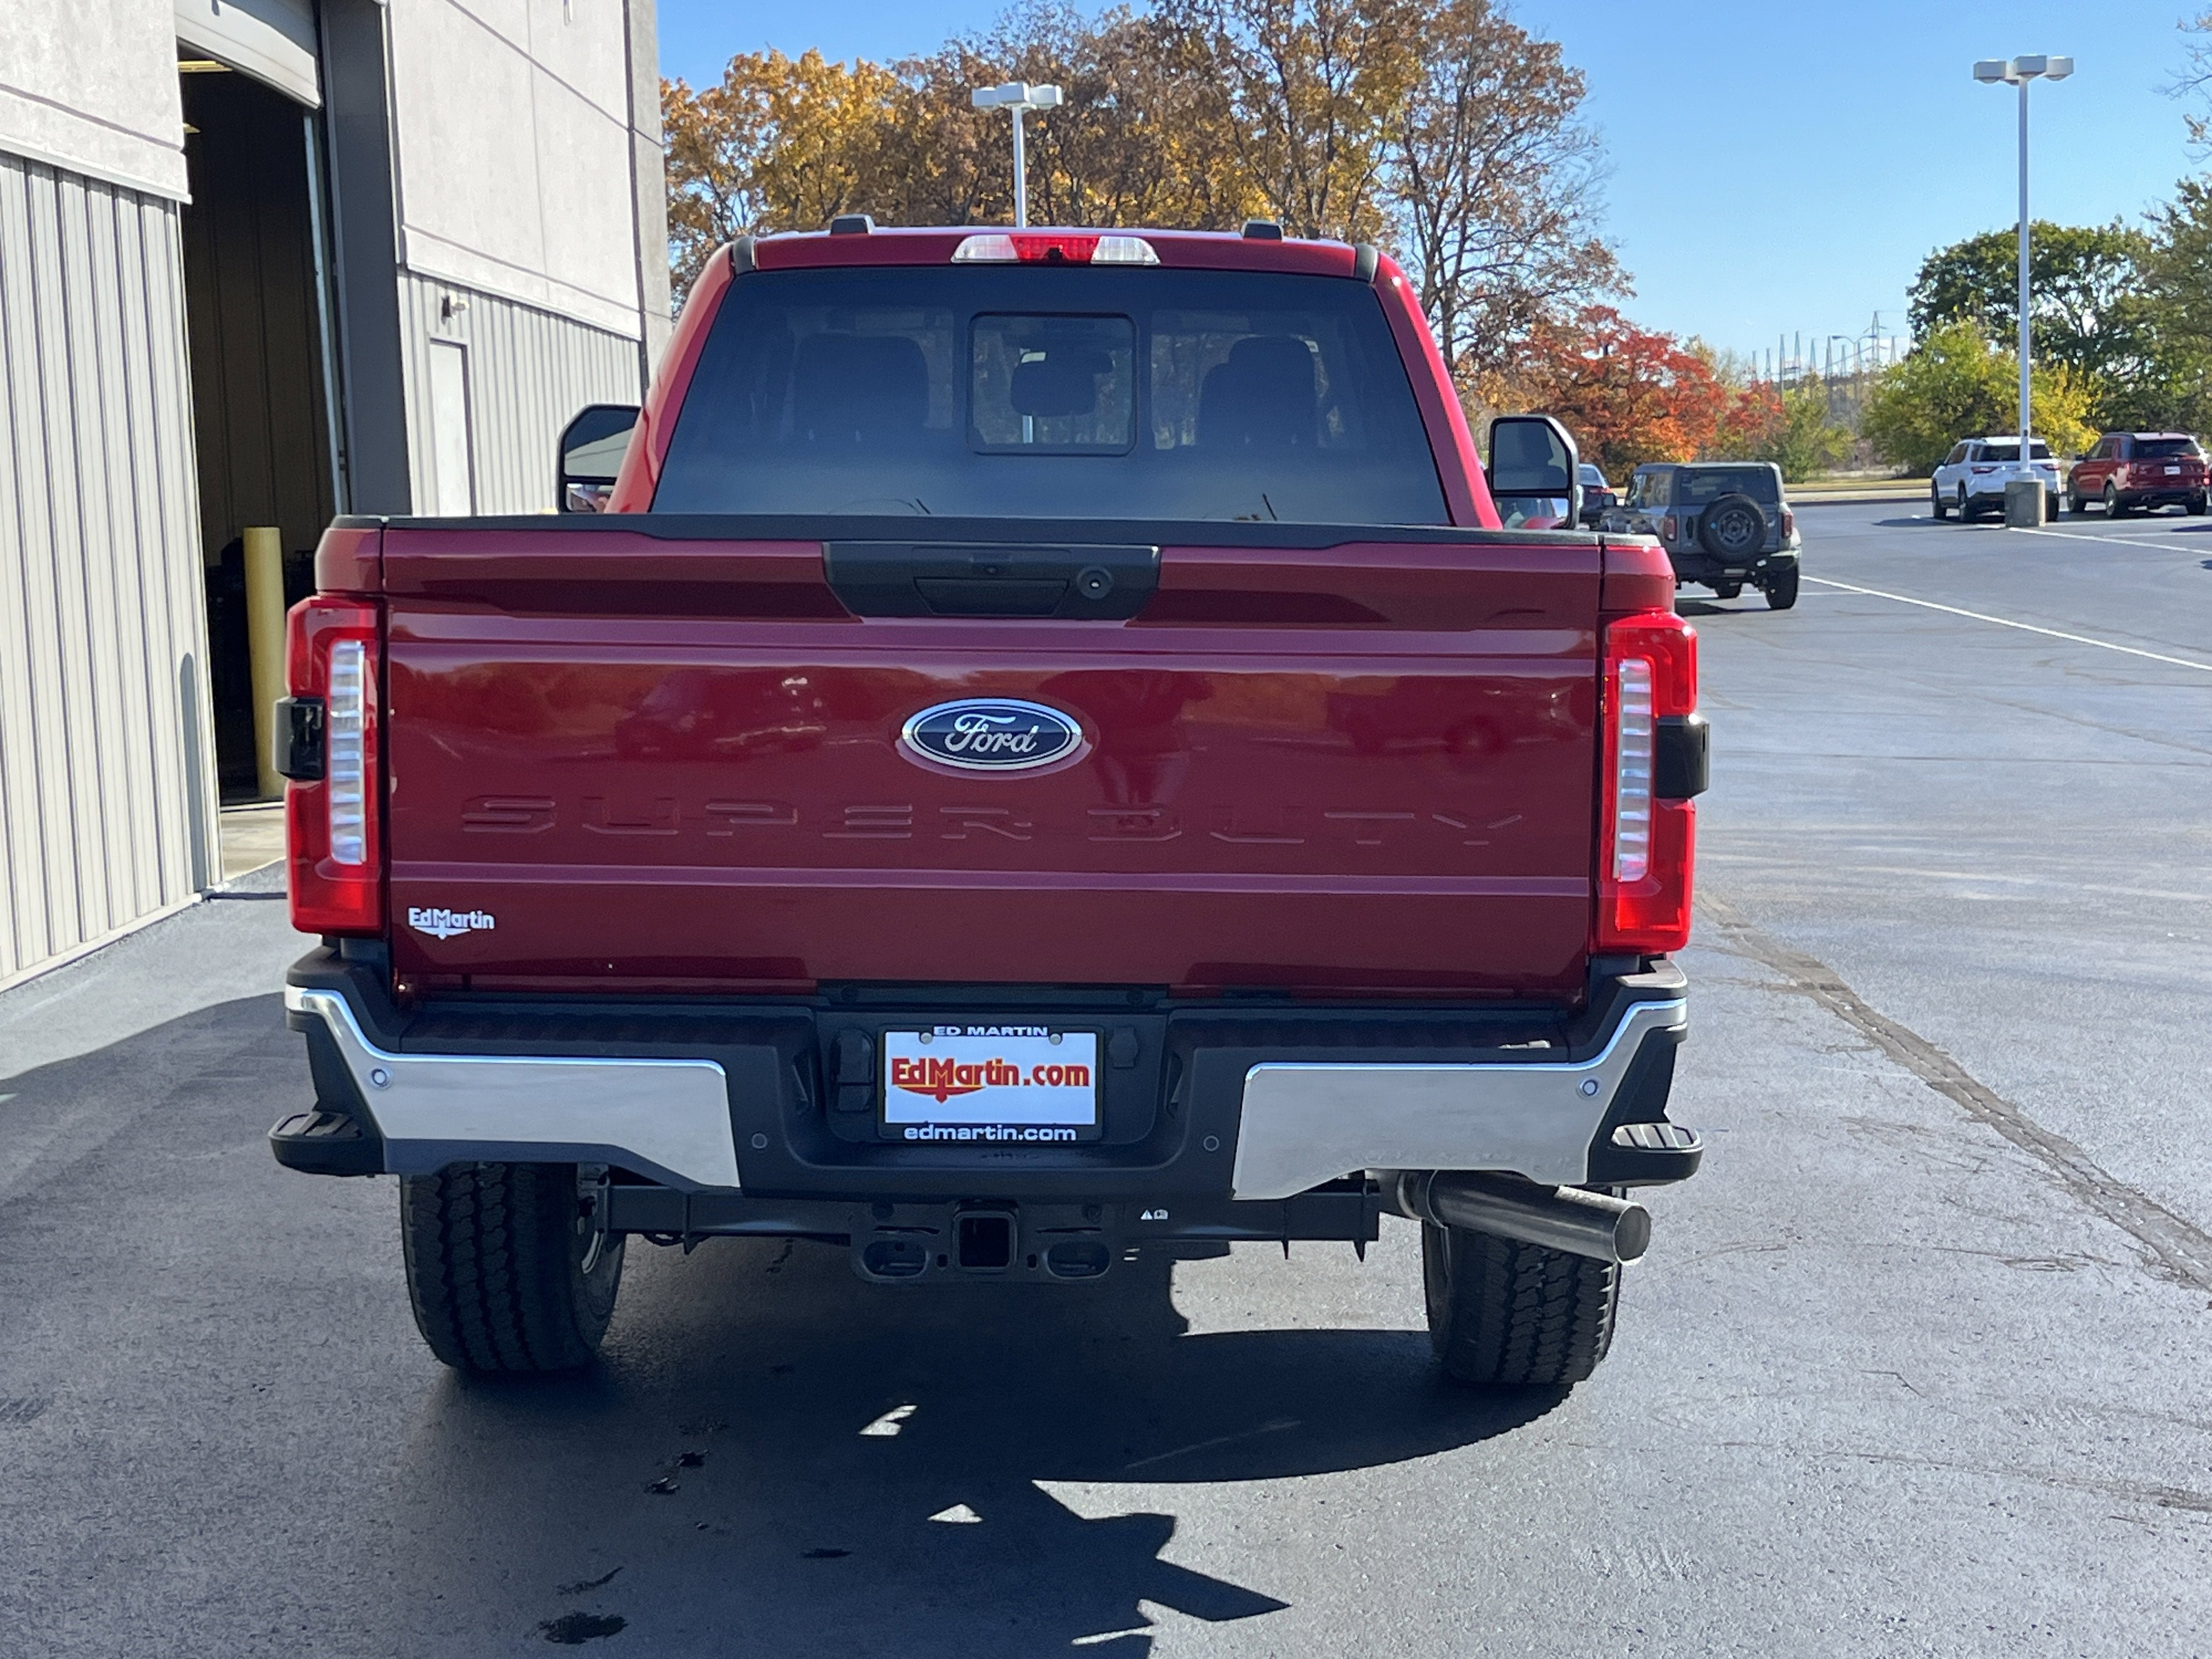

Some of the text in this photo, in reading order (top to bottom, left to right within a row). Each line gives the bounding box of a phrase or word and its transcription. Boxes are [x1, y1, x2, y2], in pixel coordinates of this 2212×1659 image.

[944, 713, 1041, 753] Ford
[461, 794, 1523, 845] SUPER DUTY
[408, 907, 495, 930] EdMartin
[934, 1026, 1048, 1036] ED MARTIN
[891, 1058, 1090, 1086] EdMartin.com
[904, 1125, 1077, 1141] edmartin.com
